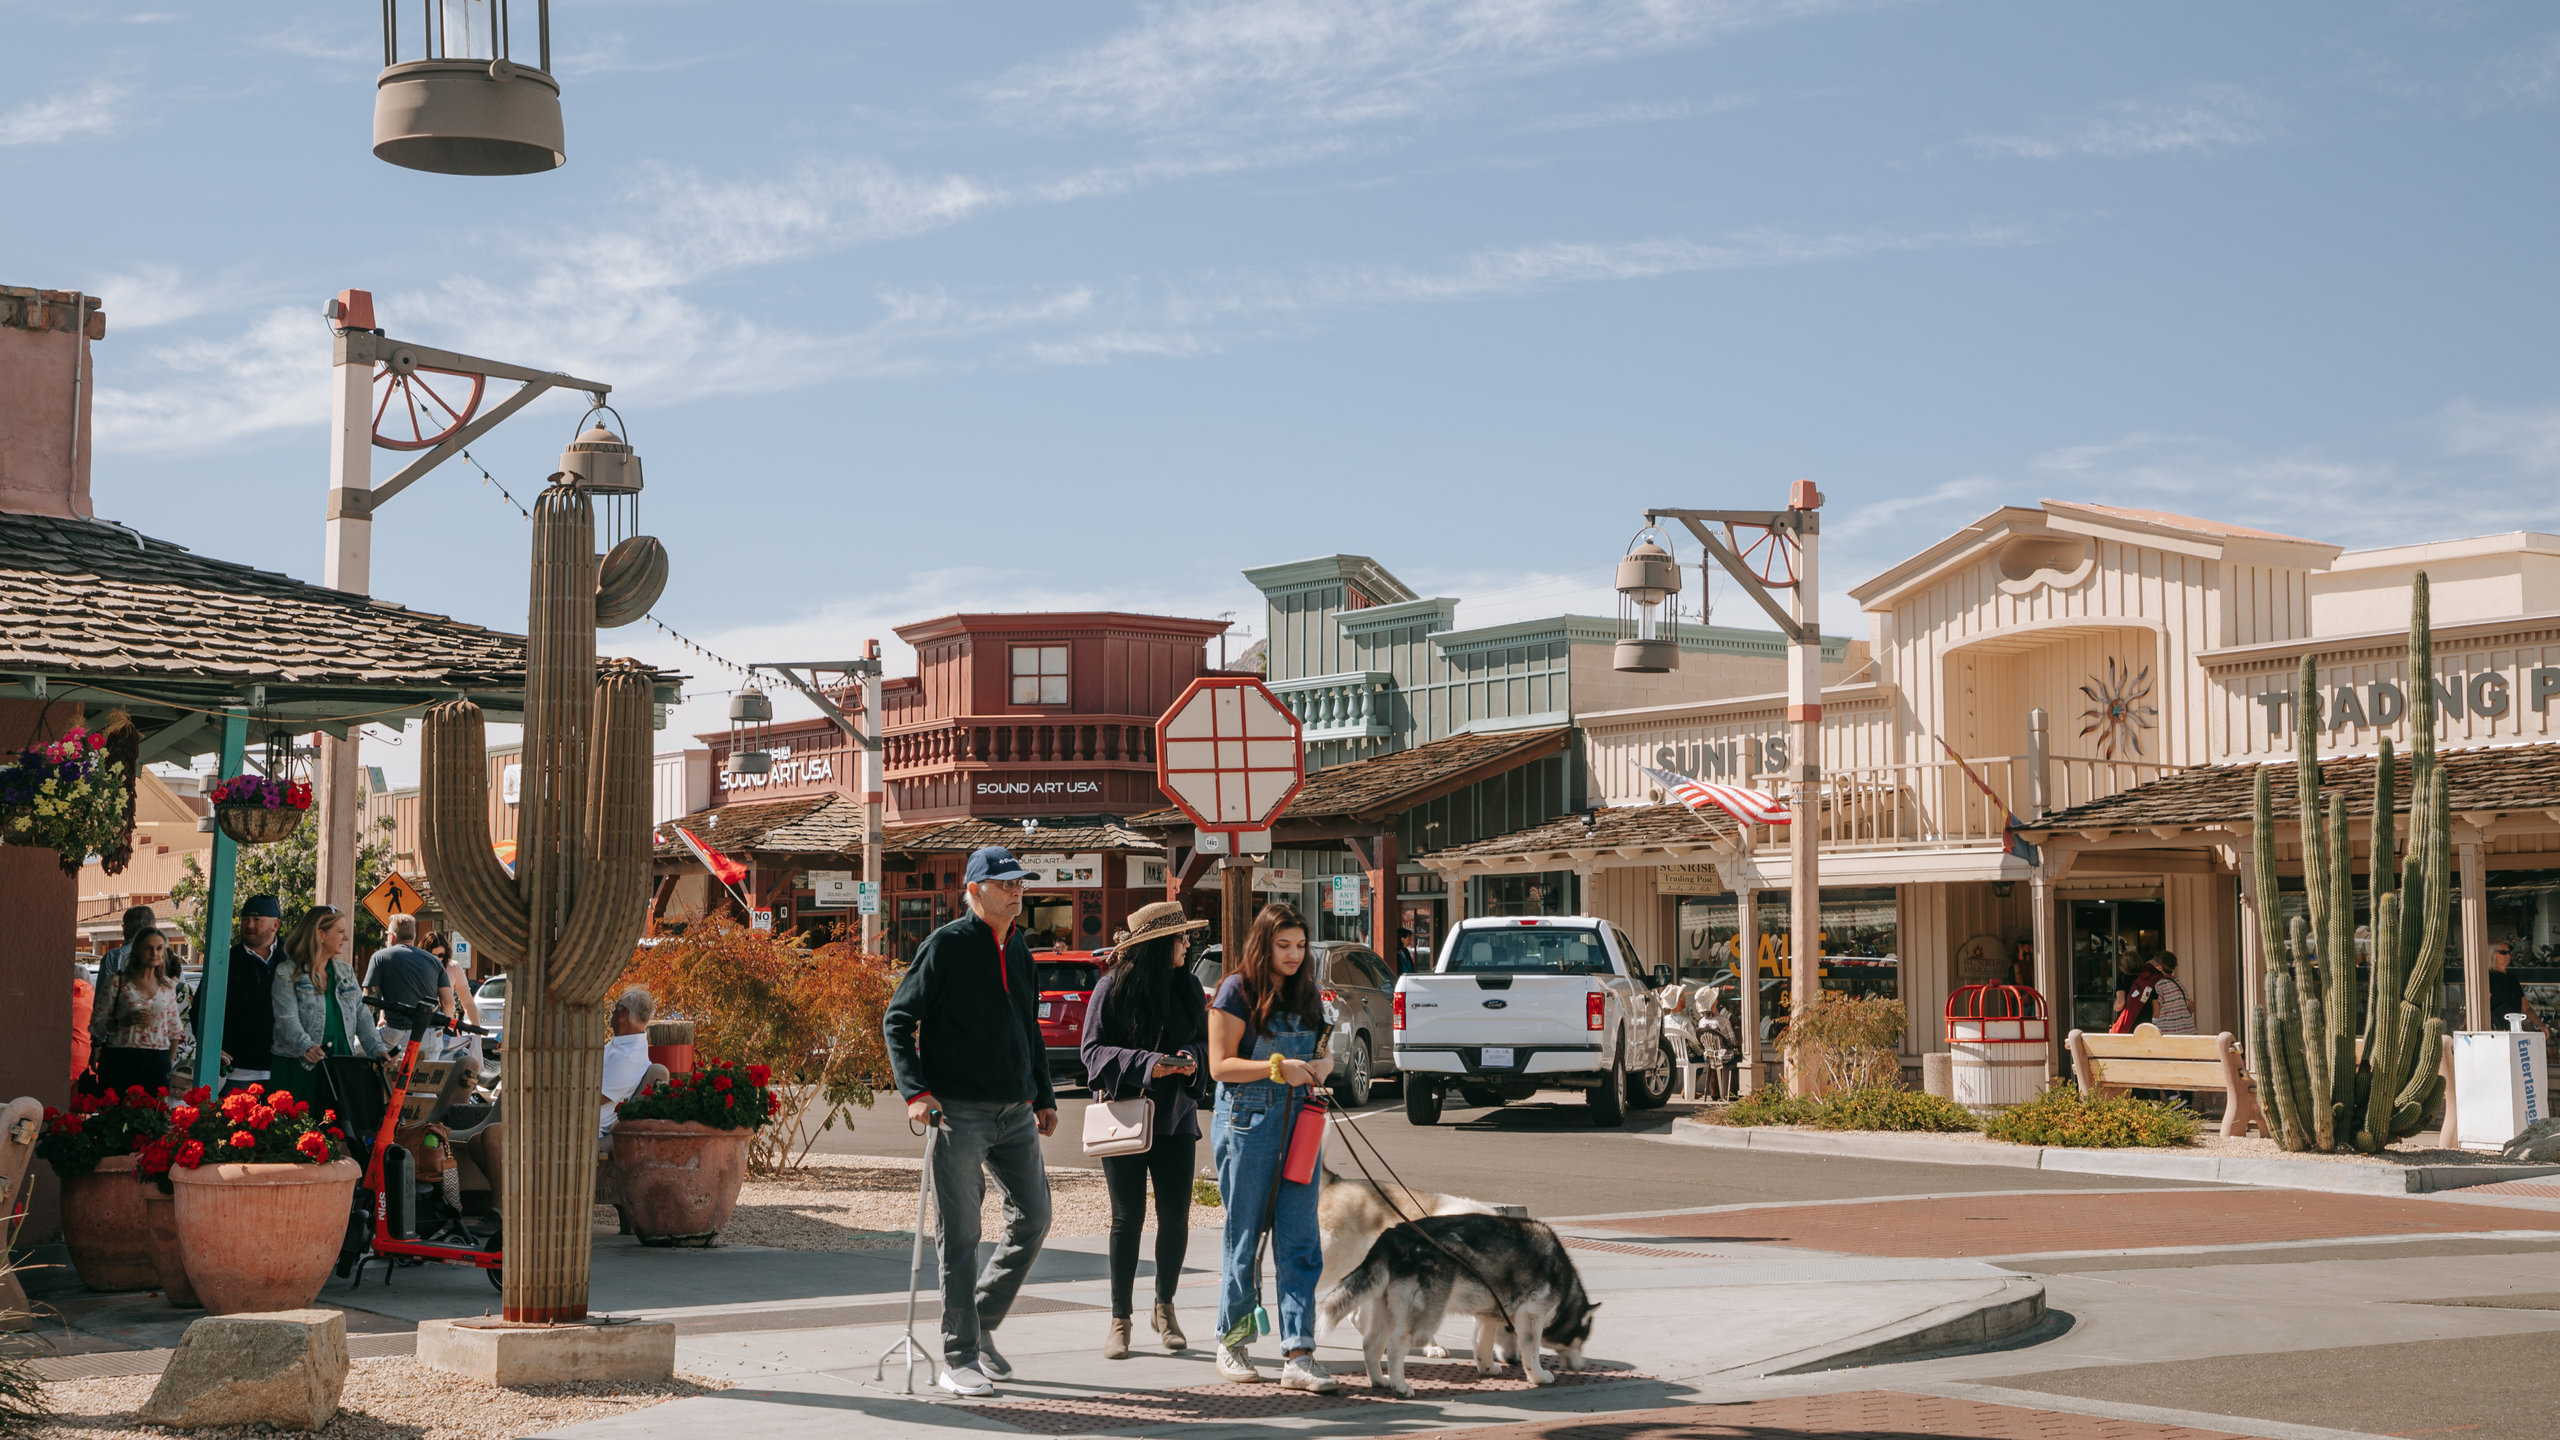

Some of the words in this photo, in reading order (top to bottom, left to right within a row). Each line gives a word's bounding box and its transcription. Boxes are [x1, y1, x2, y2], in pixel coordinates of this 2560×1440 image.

[2257, 668, 2509, 734] TADNG
[1656, 737, 1791, 778] SUNIS
[720, 770, 768, 790] SOUND
[769, 762, 798, 784] ART
[800, 758, 833, 781] USA
[977, 782, 1030, 795] SOUND
[1033, 782, 1065, 793] ART
[1066, 781, 1099, 793] USA
[1659, 863, 1716, 874] SUNRISE
[1335, 878, 1342, 890] 3
[1664, 874, 1695, 884] Trading
[1079, 890, 1103, 900] 7240
[755, 912, 770, 921] NO
[378, 1192, 387, 1221] SPIN
